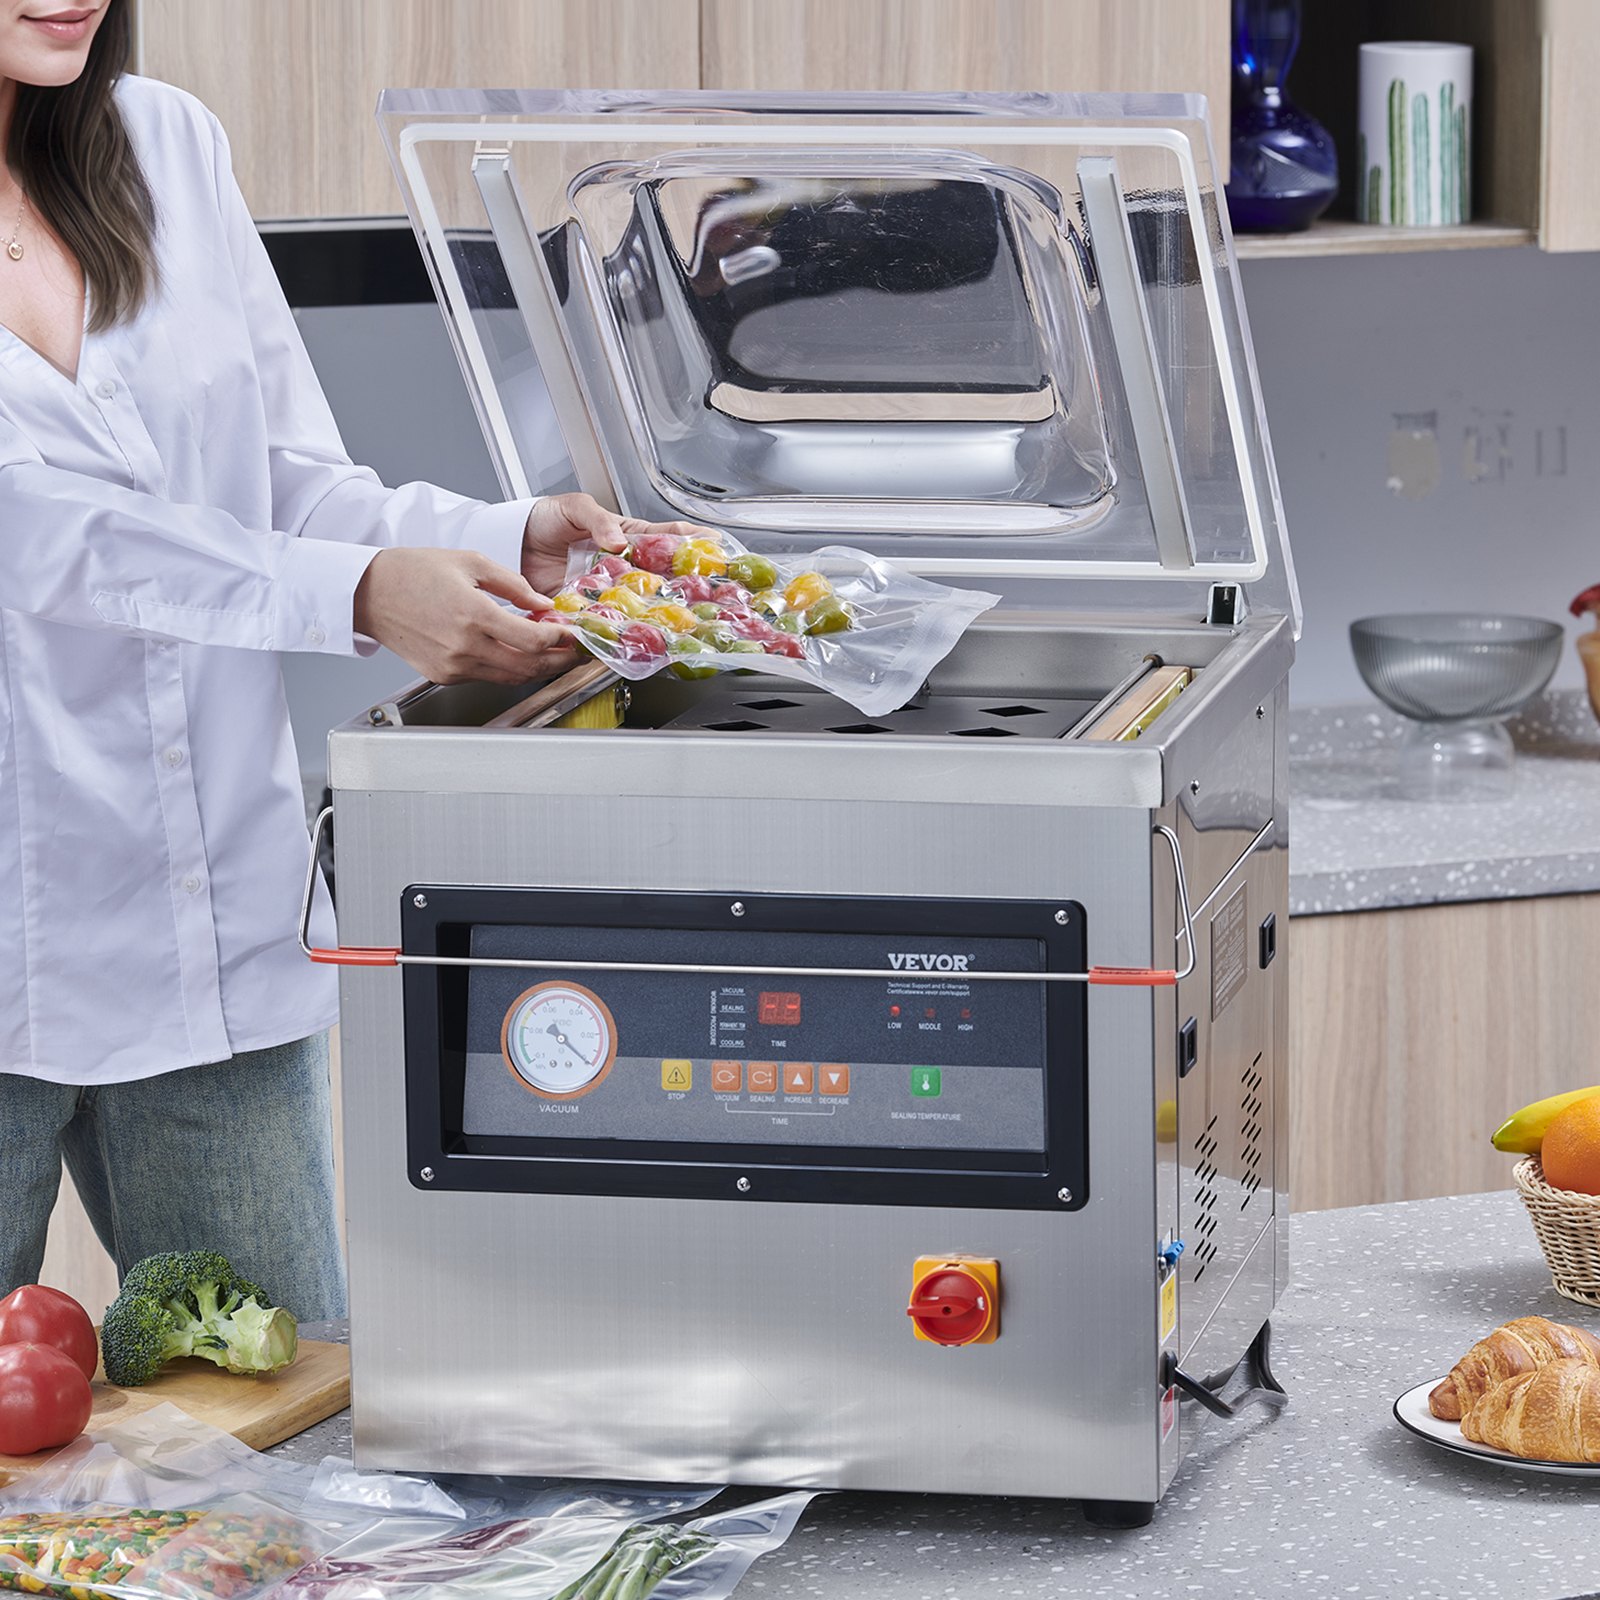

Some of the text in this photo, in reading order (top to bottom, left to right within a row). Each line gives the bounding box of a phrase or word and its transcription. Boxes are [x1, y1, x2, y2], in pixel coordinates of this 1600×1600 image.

[918, 1022, 941, 1030] MIDDLE
[770, 1040, 786, 1048] TIME
[750, 1095, 776, 1103] SEALING
[818, 1097, 849, 1106] DECREASE
[538, 1104, 580, 1114] VACUUM
[890, 1112, 961, 1121] SEALING TEMPERATURE
[771, 1118, 789, 1126] TIME
